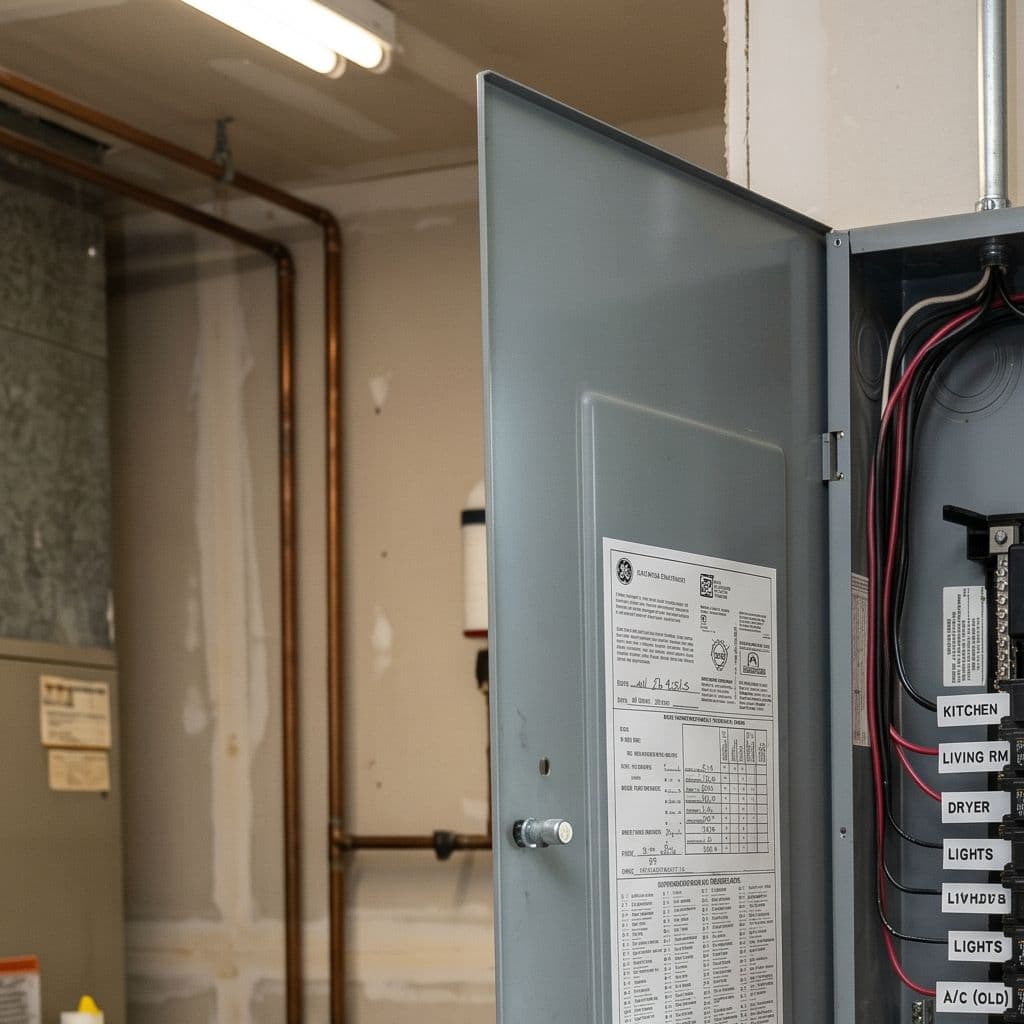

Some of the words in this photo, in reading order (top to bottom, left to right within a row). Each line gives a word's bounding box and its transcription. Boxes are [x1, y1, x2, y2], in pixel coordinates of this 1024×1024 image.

[943, 703, 998, 718] KITCHEN
[943, 751, 985, 765] LIVING
[989, 750, 1009, 762] RM
[948, 801, 990, 814] DRYER
[948, 847, 994, 861] LIGHTS
[954, 940, 1003, 953] LIGHTS
[943, 989, 968, 1004] A/C
[973, 989, 1009, 1007] (OLD)
